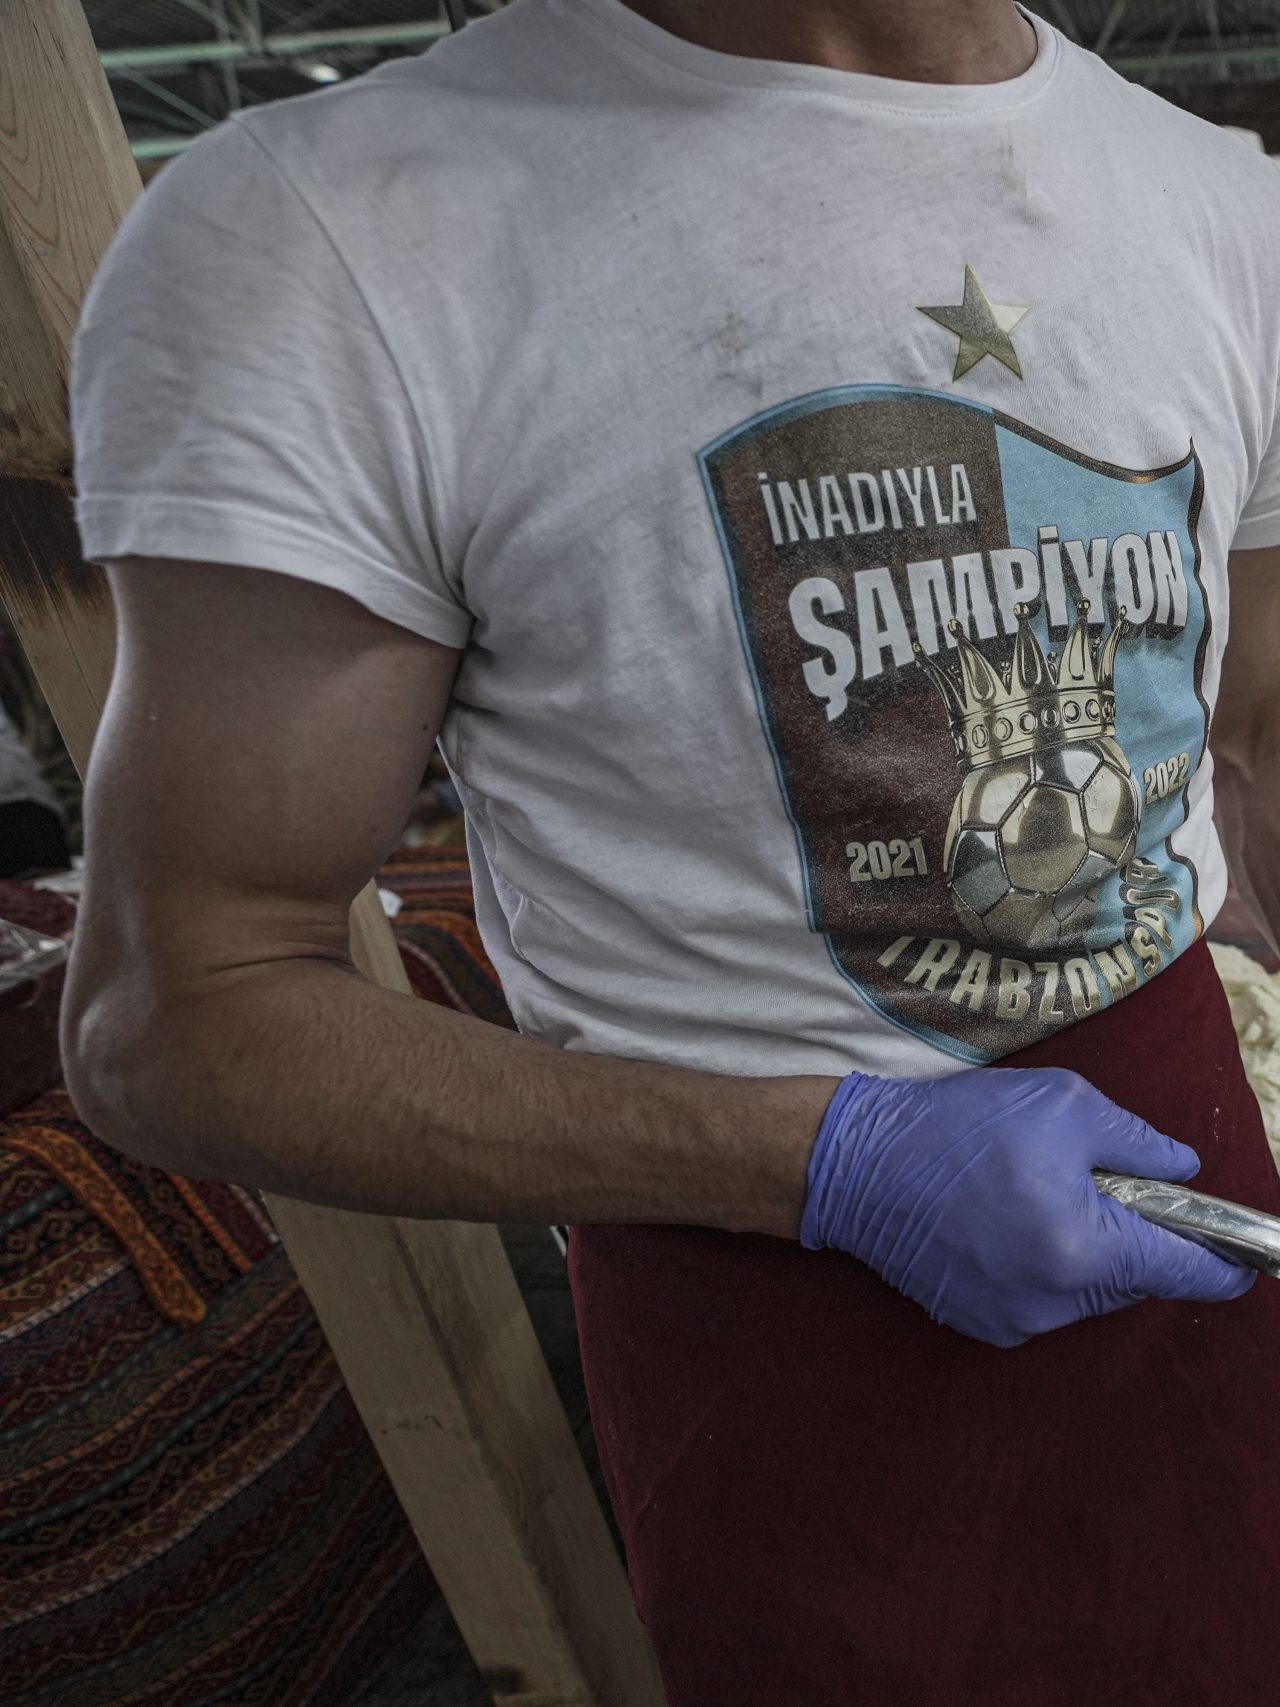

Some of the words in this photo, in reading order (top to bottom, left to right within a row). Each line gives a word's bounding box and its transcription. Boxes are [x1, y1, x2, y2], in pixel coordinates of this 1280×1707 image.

[758, 464, 977, 545] İNADIYLA
[788, 525, 1188, 721] ŞAMPİYON
[1144, 752, 1190, 805] 2022
[846, 836, 929, 882] 2021
